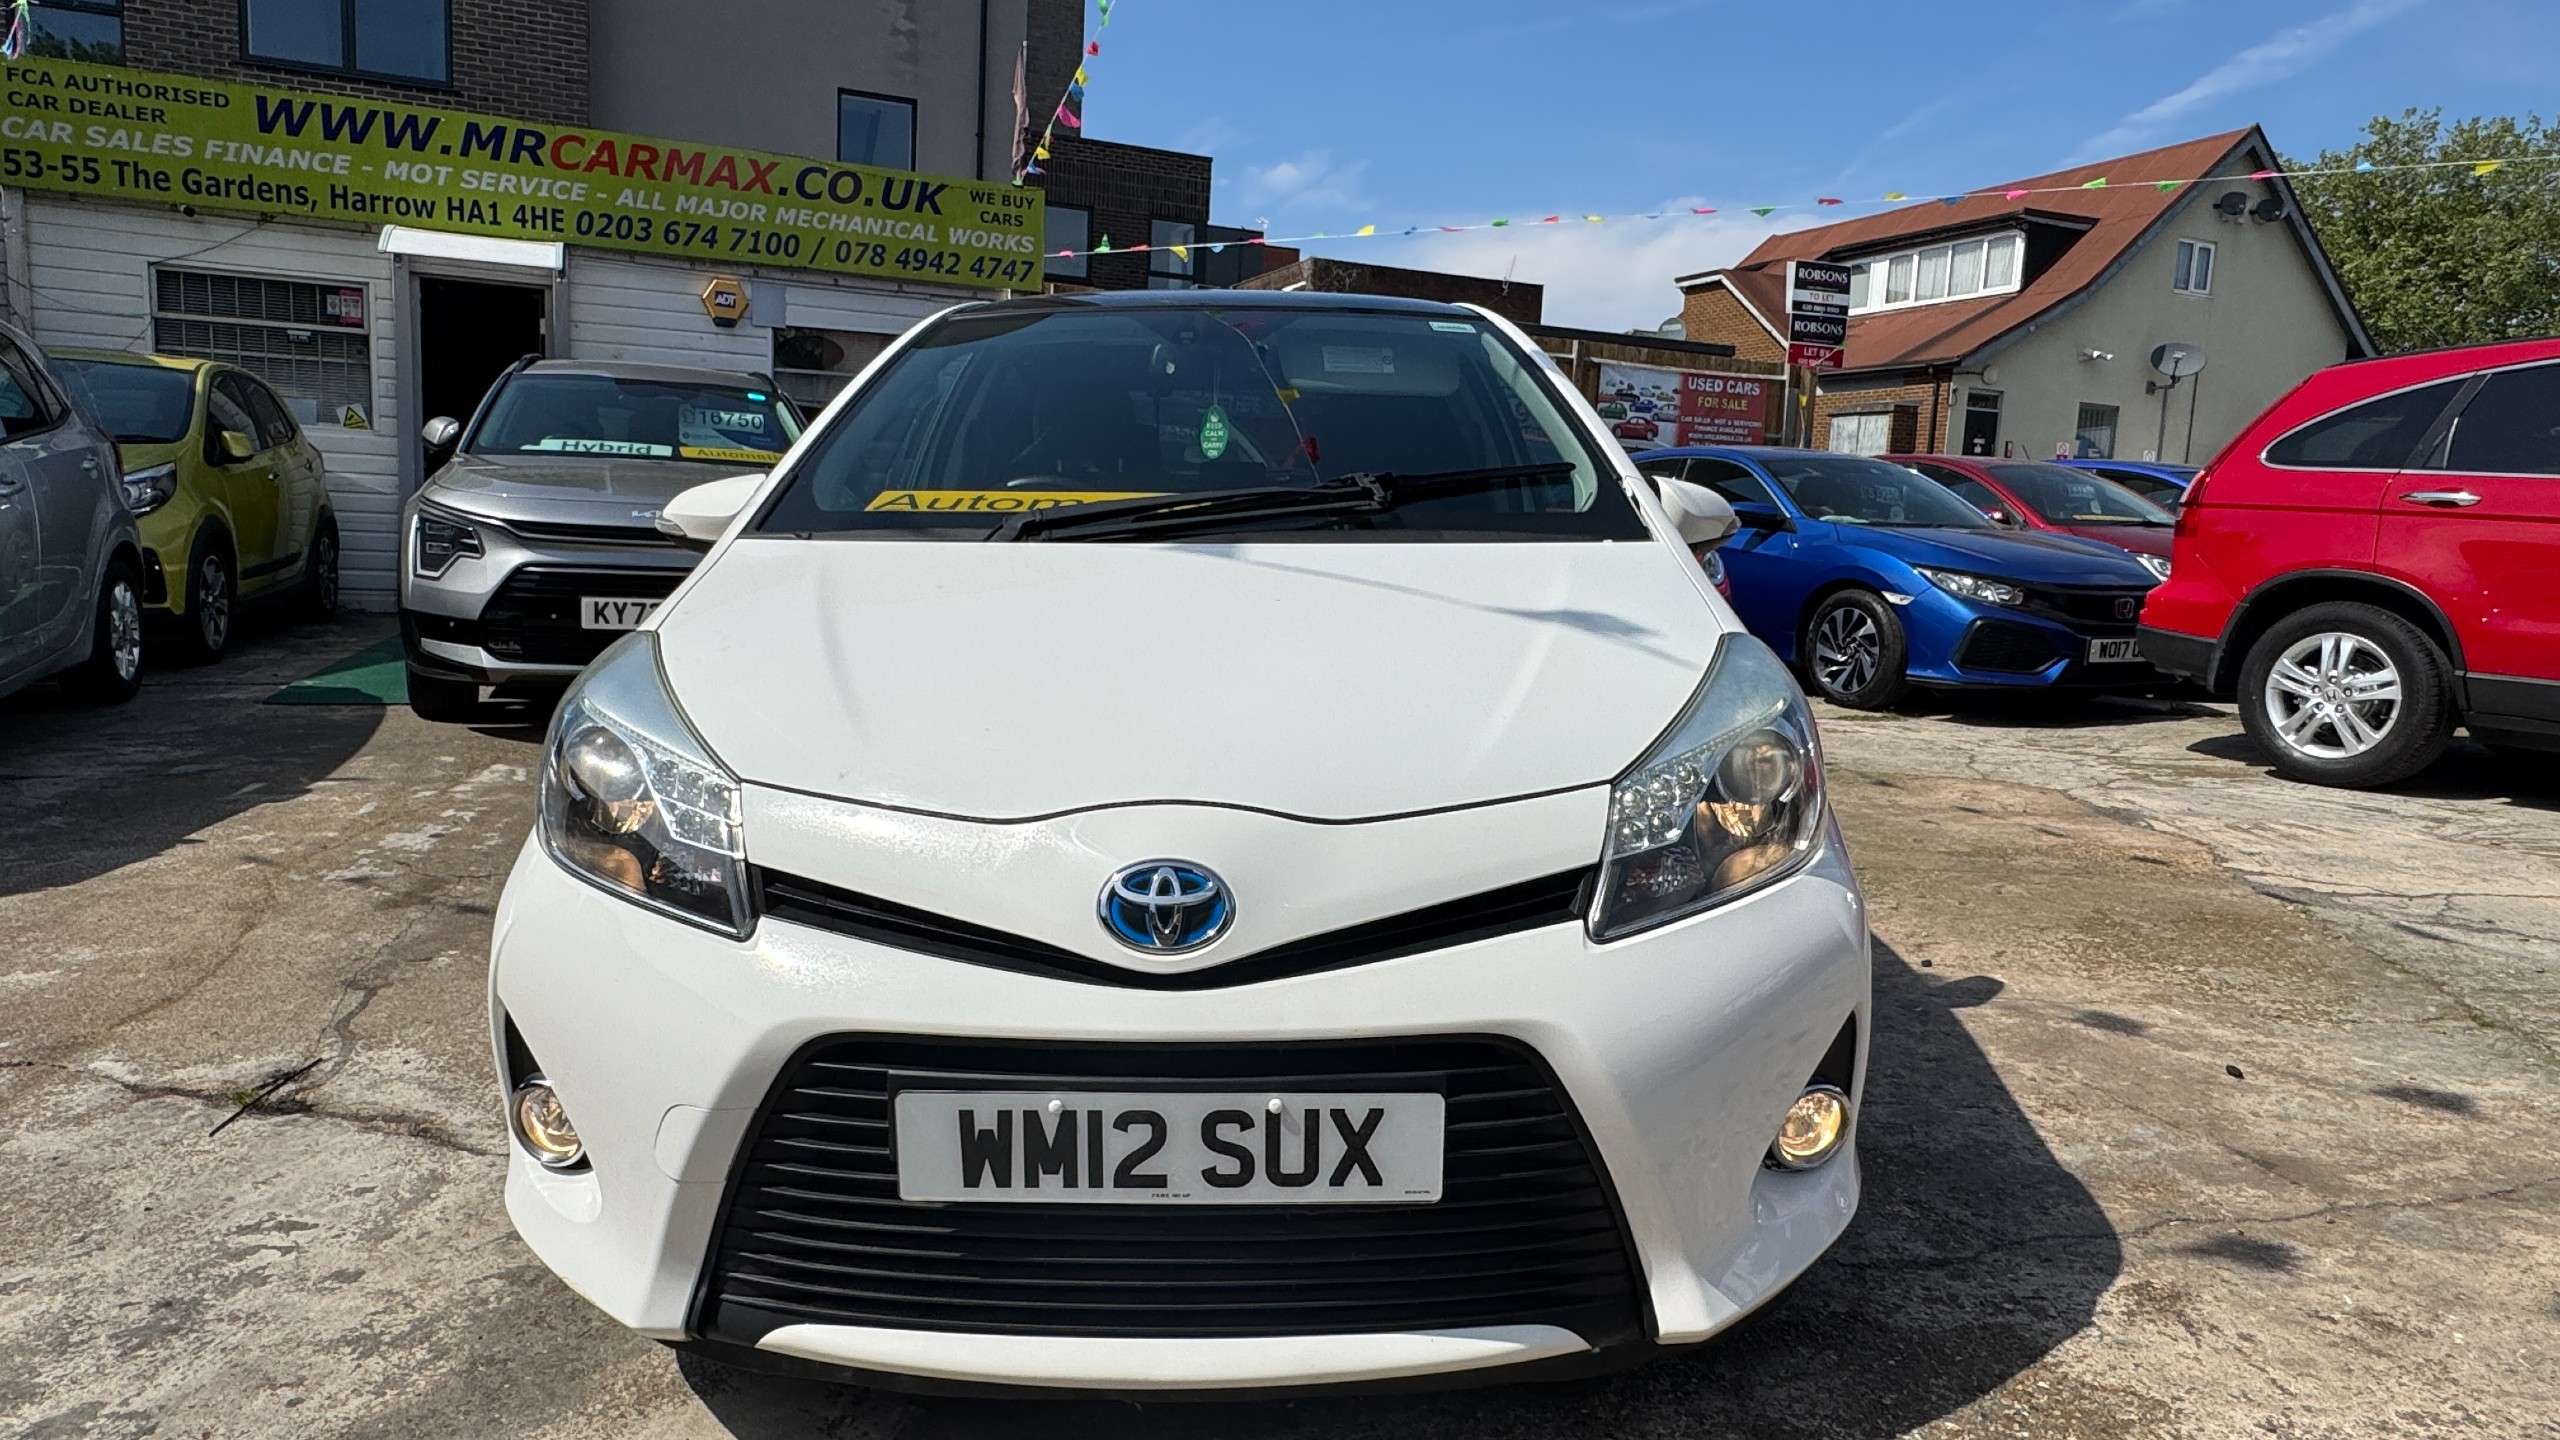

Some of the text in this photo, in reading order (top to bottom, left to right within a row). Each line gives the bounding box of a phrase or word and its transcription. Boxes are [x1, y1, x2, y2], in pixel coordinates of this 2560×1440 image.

[6, 66, 231, 108] FCA AUTHORISED
[7, 91, 168, 124] CAR DEALER
[255, 94, 949, 216] WWW.MRCARMAX.CO.UK
[2, 116, 73, 144] CAR
[85, 125, 194, 156] SALES
[204, 139, 353, 175] FINANCE
[384, 160, 454, 187] MOT
[460, 169, 588, 201] SERVICE
[615, 188, 666, 212] ALL
[675, 194, 768, 223] MAJOR
[775, 206, 938, 242] MECHANICAL
[949, 227, 1035, 253] WORKS
[970, 190, 1035, 210] WE BUY
[3, 149, 101, 185] 53-55
[111, 159, 171, 191] The
[181, 167, 318, 213] Gardens,
[330, 183, 437, 220] Harrow
[447, 196, 502, 226] HA1
[512, 204, 565, 233] 4HE
[575, 210, 653, 242] 0203
[663, 220, 719, 249] 674
[729, 228, 800, 258] 7100
[835, 240, 886, 267] 078
[895, 248, 961, 275] 4942
[969, 256, 1035, 283] 4747
[980, 211, 1024, 227] CARS
[1798, 267, 1848, 284] ROBSONS
[715, 293, 736, 307] ADT
[1794, 320, 1843, 336] ROBSONS
[1688, 376, 1761, 396] USED CARS
[1698, 397, 1748, 411] FOR SALE
[561, 440, 652, 456] Hybrid
[958, 1108, 1385, 1190] WM12 SUX
